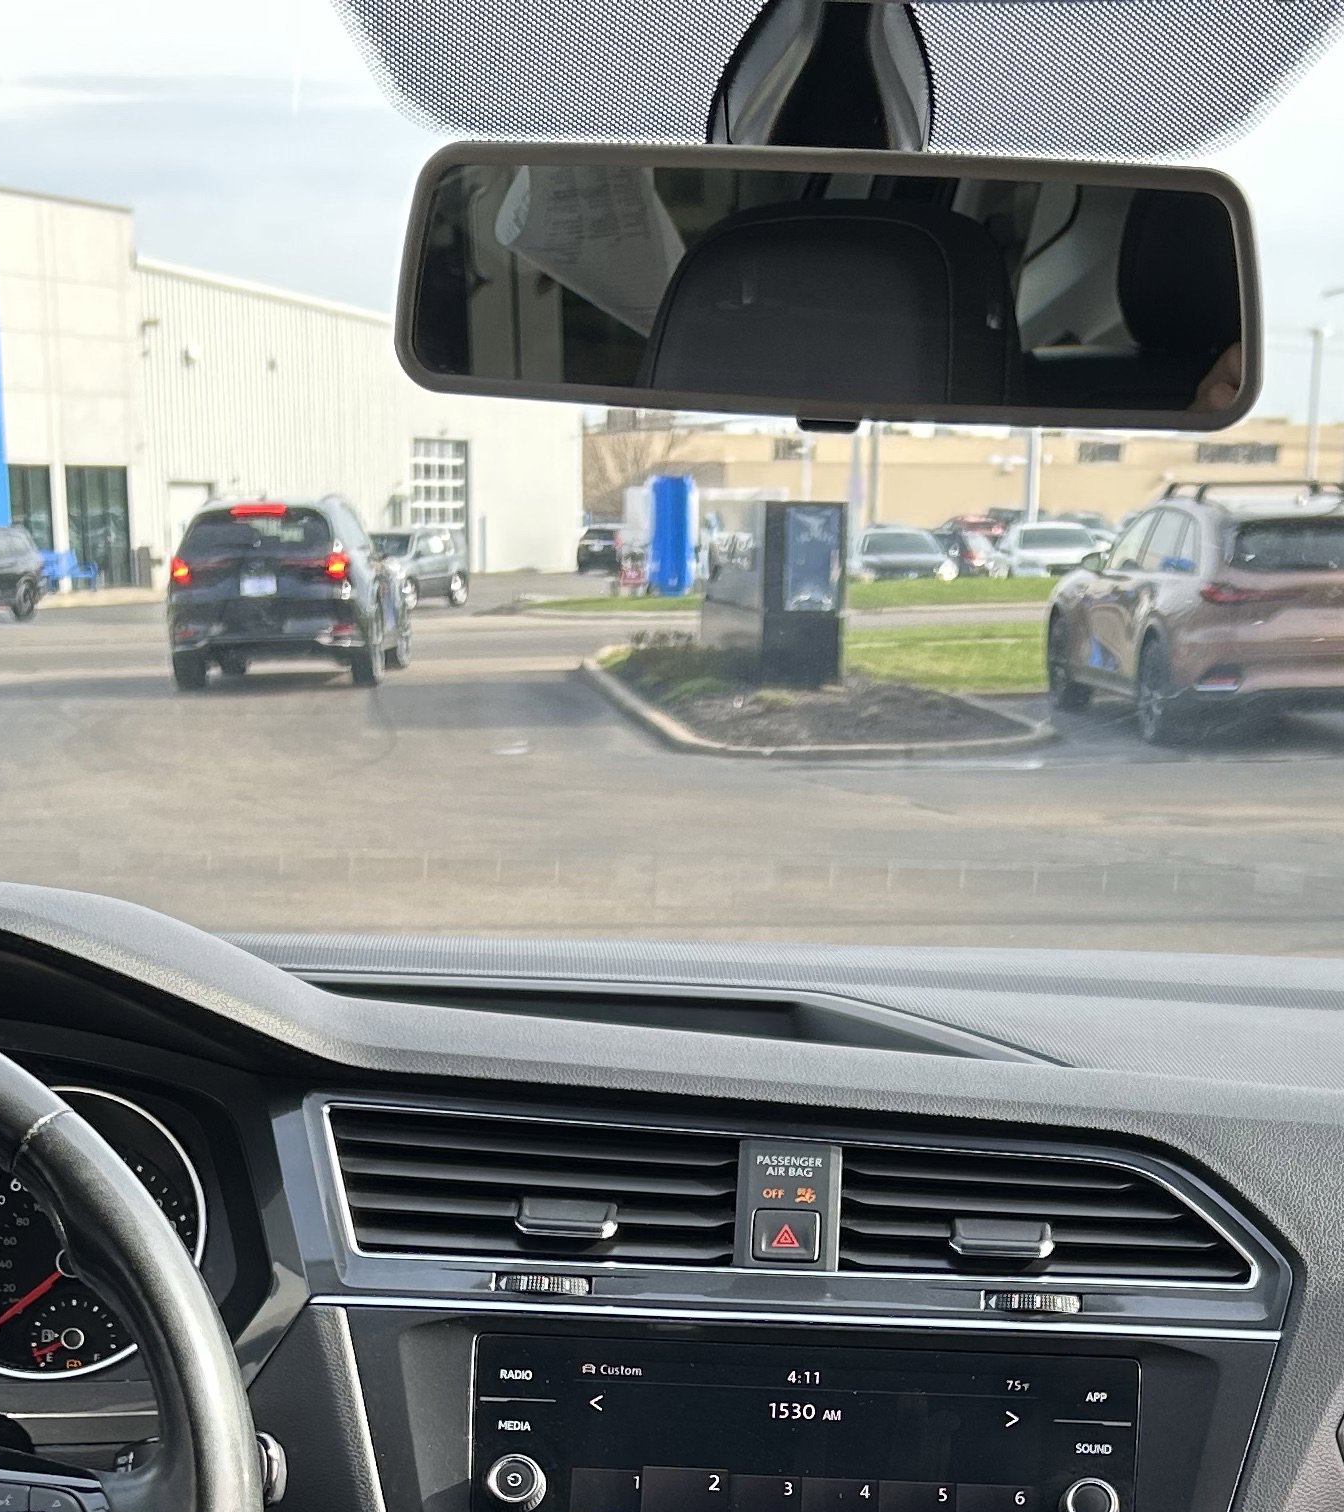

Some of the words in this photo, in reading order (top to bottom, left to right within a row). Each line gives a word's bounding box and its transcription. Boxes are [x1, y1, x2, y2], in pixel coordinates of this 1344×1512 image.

[756, 1155, 823, 1168] PASSENGER
[765, 1167, 786, 1176] AIR
[788, 1168, 813, 1178] BAG
[762, 1188, 785, 1199] OFF
[16, 1216, 30, 1226] 80
[46, 1352, 53, 1362] E
[499, 1368, 533, 1381] RADIO
[600, 1364, 643, 1377] Custom
[787, 1370, 820, 1385] 4:11
[1085, 1391, 1108, 1402] APP
[768, 1402, 816, 1420] 1530
[822, 1409, 842, 1422] AM
[497, 1420, 531, 1432] MEDIA
[1075, 1442, 1112, 1455] SOUND
[633, 1475, 640, 1490] 1
[708, 1474, 721, 1492] 2
[783, 1481, 793, 1497] 3
[859, 1485, 871, 1500] 4
[938, 1487, 948, 1502] 5
[1014, 1490, 1026, 1506] 6
